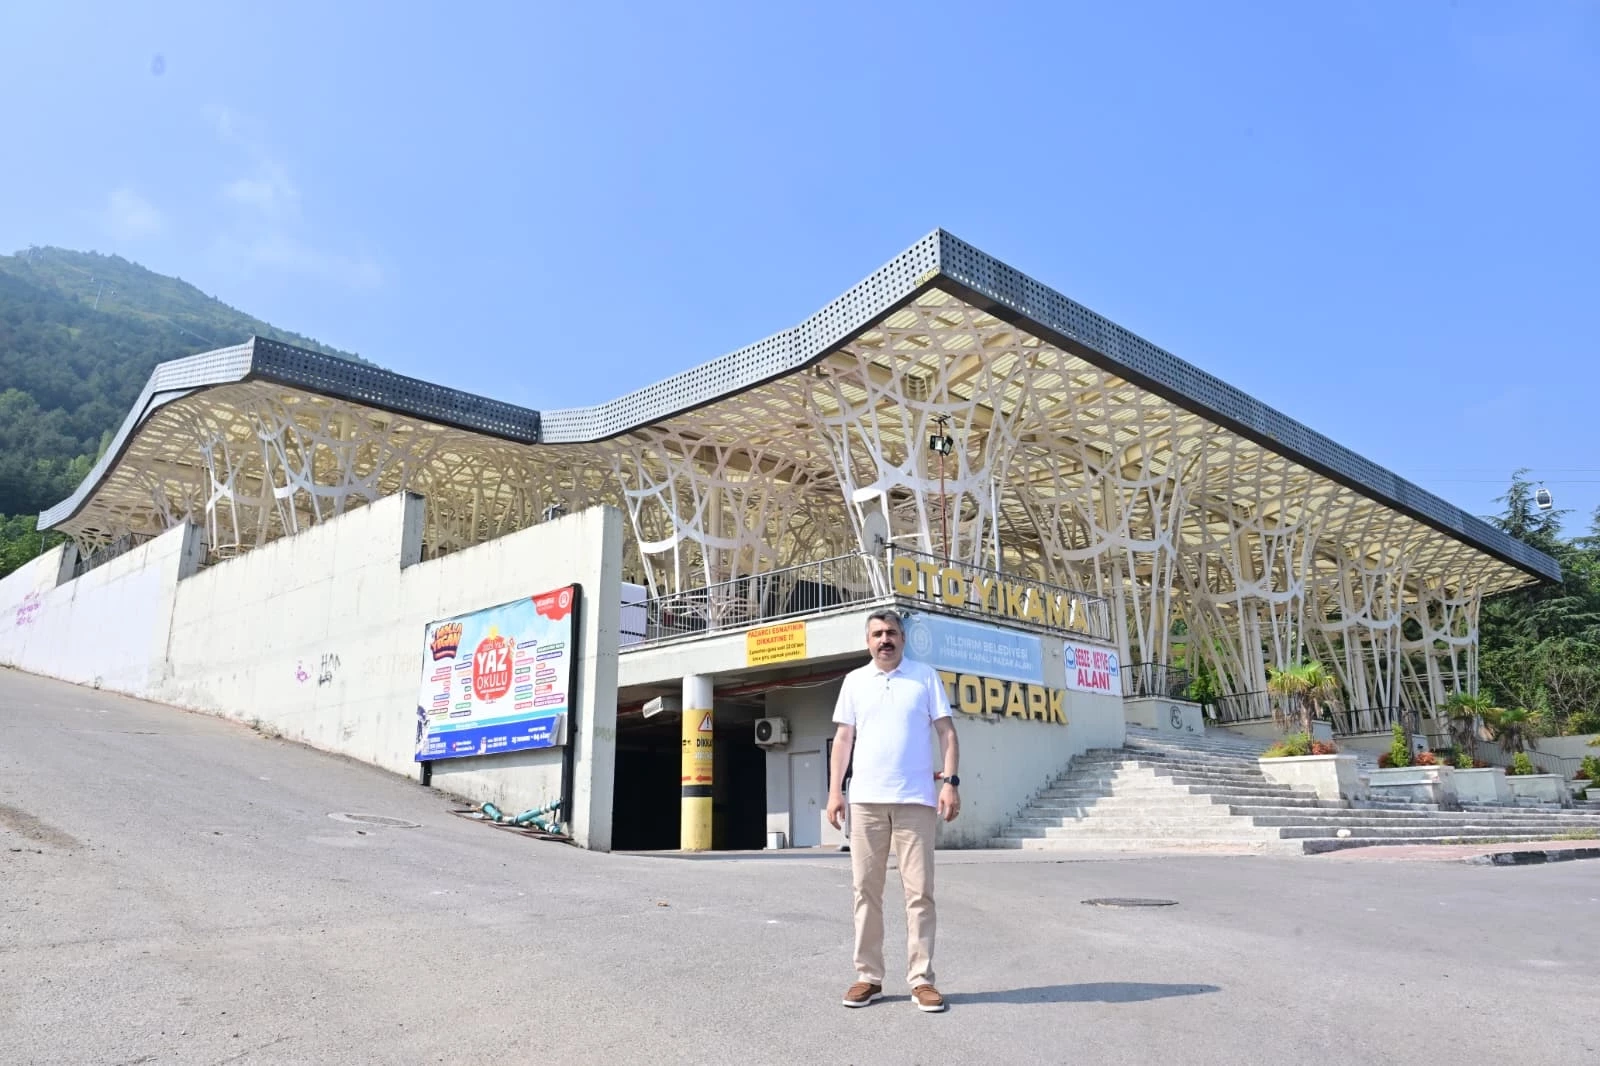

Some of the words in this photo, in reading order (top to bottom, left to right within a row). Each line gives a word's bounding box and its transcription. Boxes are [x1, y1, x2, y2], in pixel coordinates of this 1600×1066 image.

[894, 556, 965, 607] OTO
[973, 576, 1089, 634] YIKAMA
[944, 634, 982, 650] YILDIRIM
[477, 647, 509, 675] YAZ
[477, 671, 508, 690] OKULU
[1078, 668, 1110, 690] ALANI
[938, 671, 1069, 724] TOPARK
